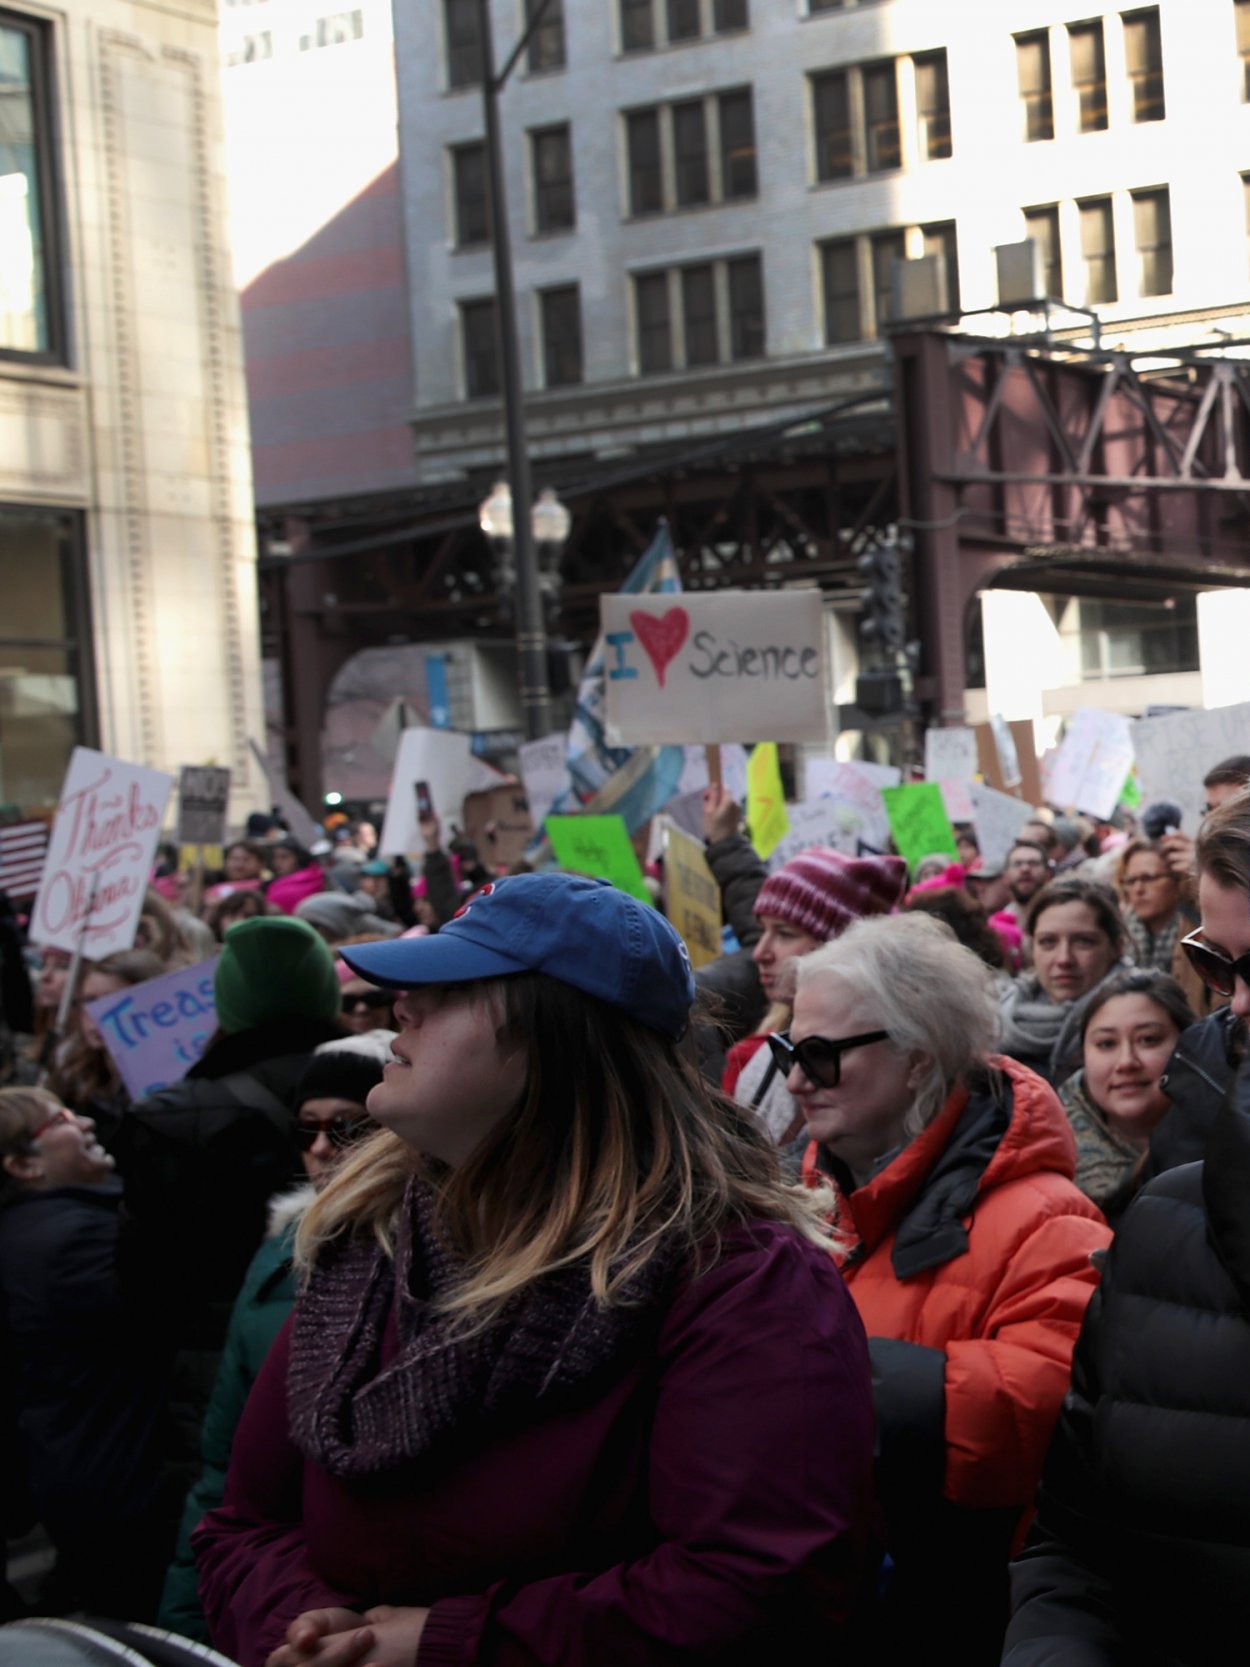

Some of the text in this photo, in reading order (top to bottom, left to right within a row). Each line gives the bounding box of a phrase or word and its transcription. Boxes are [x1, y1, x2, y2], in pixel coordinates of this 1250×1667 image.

[605, 630, 819, 680] I Science
[57, 767, 160, 864] Thanks
[41, 870, 139, 934] Obama
